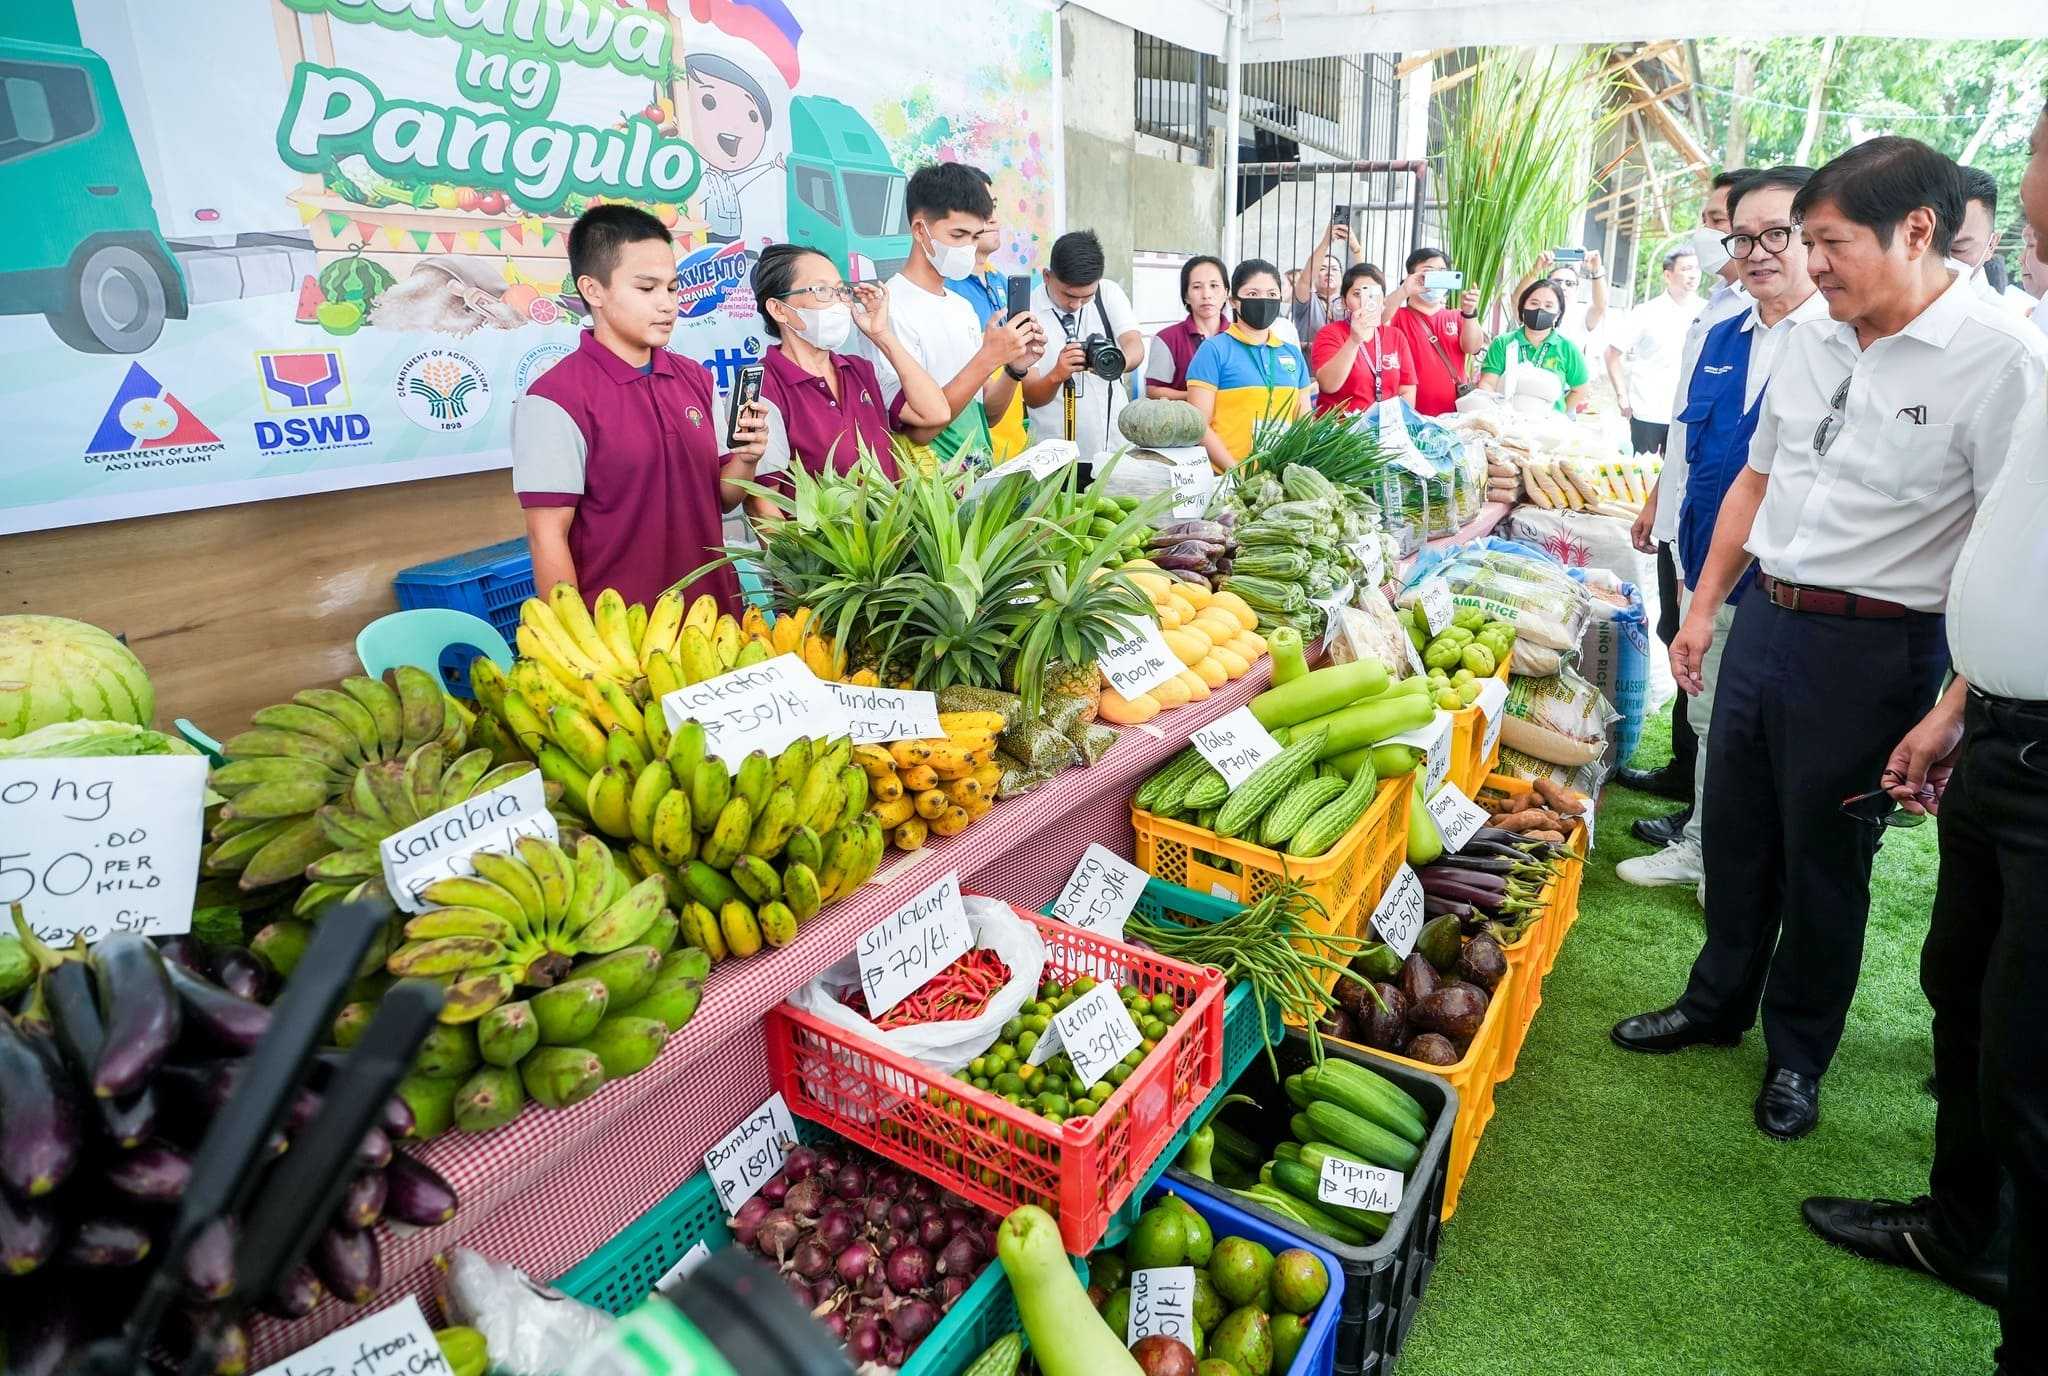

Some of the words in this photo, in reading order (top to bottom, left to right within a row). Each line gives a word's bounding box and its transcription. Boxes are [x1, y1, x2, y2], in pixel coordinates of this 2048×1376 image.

[466, 49, 551, 109] ng
[289, 71, 694, 199] Pangulo
[678, 253, 746, 289] KWENTO
[678, 286, 716, 305] ARAVAN
[397, 352, 428, 398] DEPARTMENT
[447, 351, 489, 393] AGRICULTURE
[254, 414, 371, 451] DSWD
[84, 448, 166, 464] DEPARTMENT
[186, 443, 226, 454] LABOR
[134, 454, 213, 468] EMPLOYMENT
[1452, 597, 1481, 609] AMA
[1485, 601, 1519, 620] RICE
[823, 682, 905, 712] Tundan
[1195, 730, 1237, 752] Palya
[2, 778, 113, 821] ong
[1430, 795, 1457, 817] Talong
[104, 856, 153, 875] PER
[97, 876, 161, 894] KILO
[1374, 871, 1415, 932] Avocado
[861, 924, 893, 957] Sili
[707, 1107, 776, 1170] Bombay
[1329, 1159, 1386, 1183] Pipino
